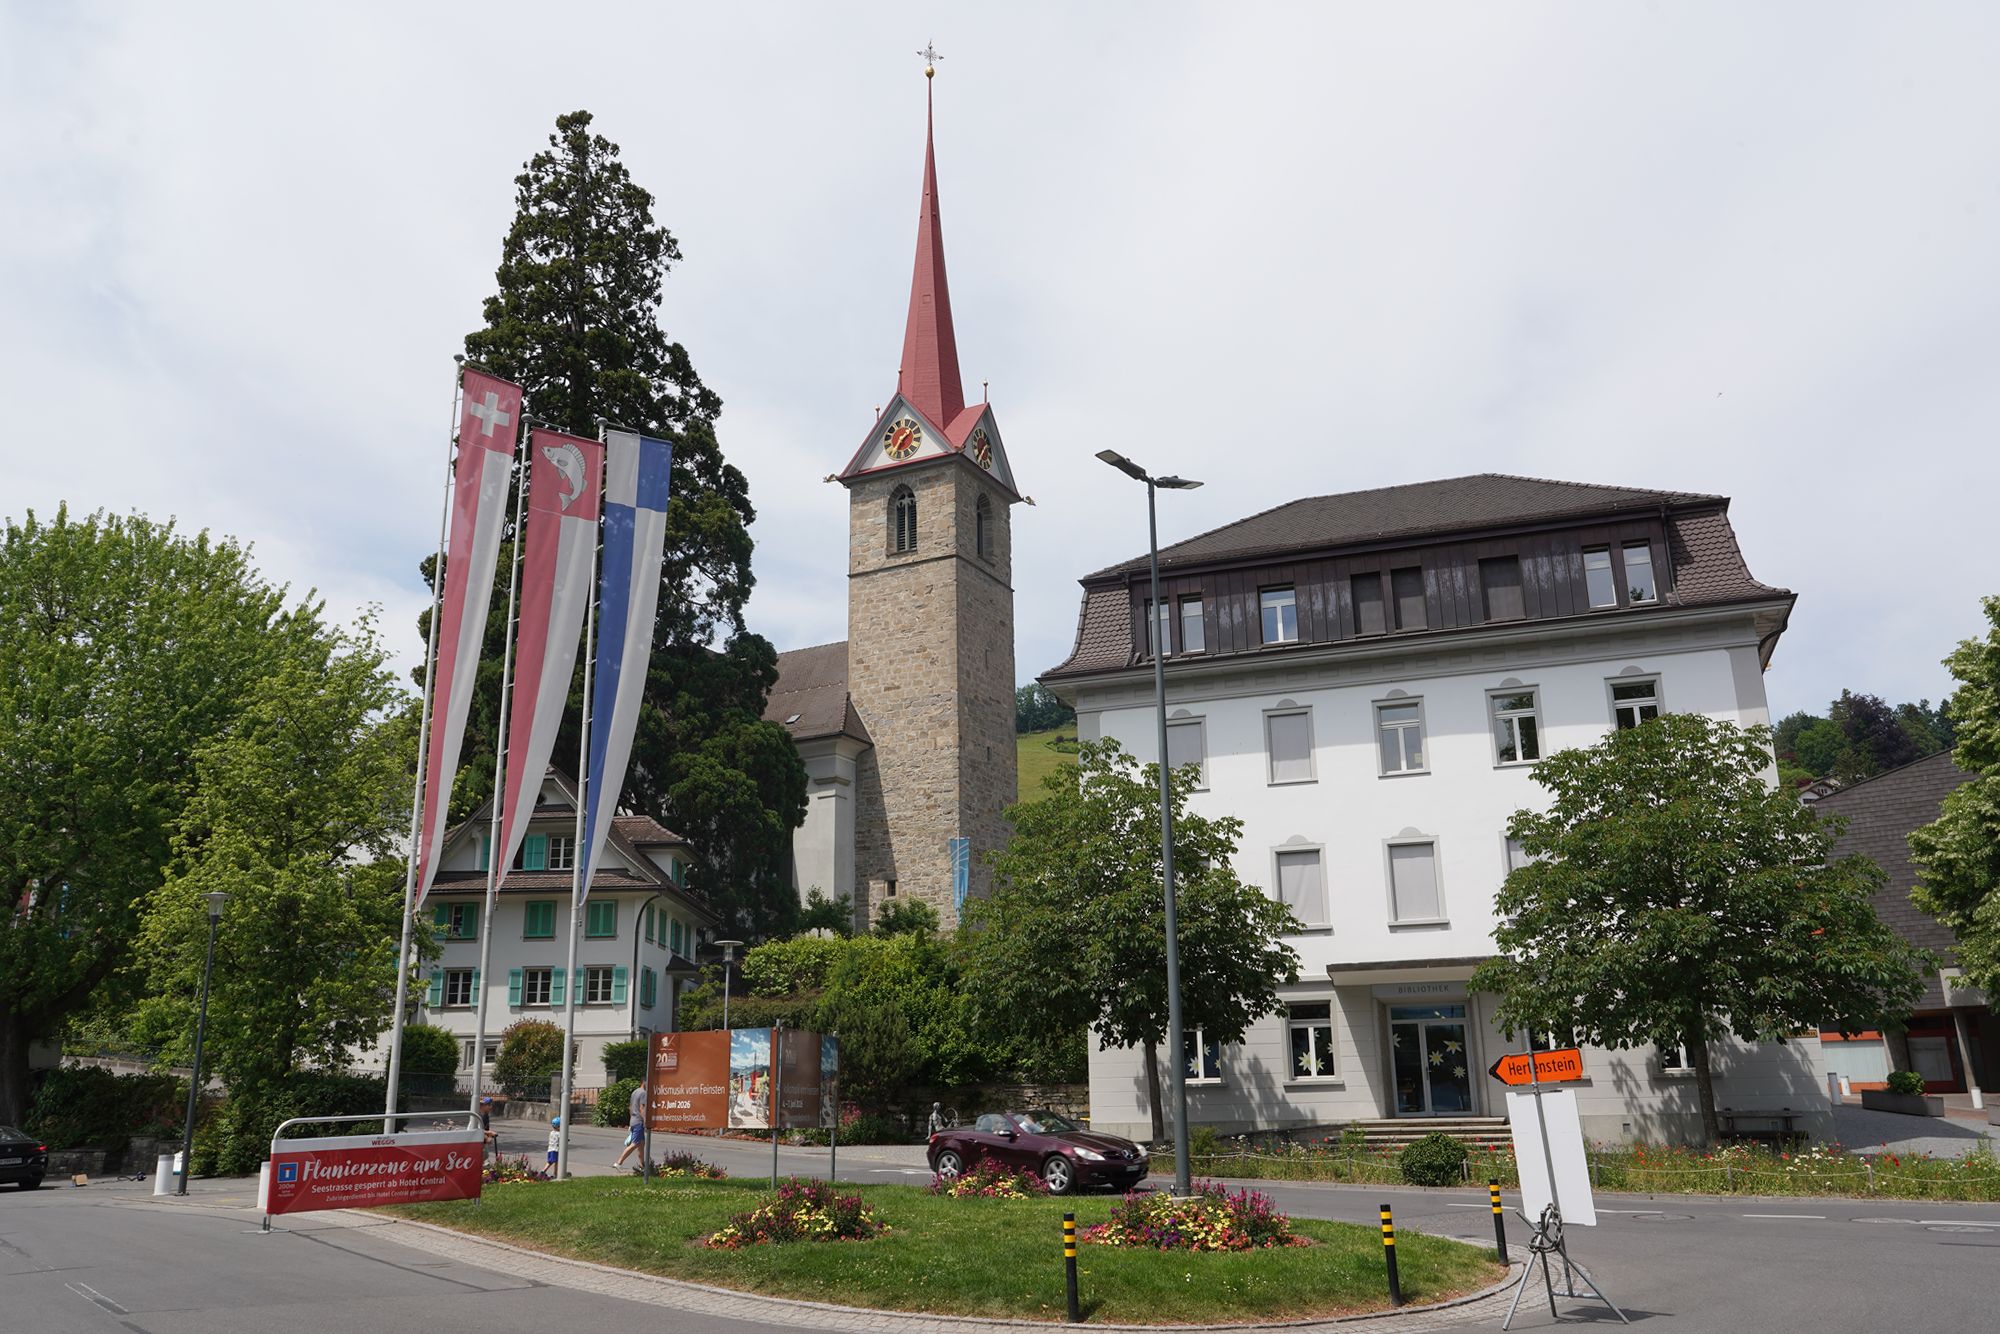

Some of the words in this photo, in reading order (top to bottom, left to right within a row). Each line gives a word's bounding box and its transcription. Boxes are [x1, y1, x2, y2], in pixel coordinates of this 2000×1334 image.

[1398, 984, 1449, 994] BIBLIOTHEK
[653, 1084, 685, 1096] Volksmusik
[685, 1086, 699, 1095] vom
[700, 1083, 726, 1095] Feinsten
[667, 1100, 677, 1110] Juni
[677, 1100, 691, 1109] 2026
[372, 1138, 396, 1146] WEGGIS
[302, 1158, 412, 1181] Flanierzone
[413, 1158, 444, 1173] am
[445, 1151, 475, 1171] See
[311, 1183, 353, 1194] Seestrasse
[353, 1180, 386, 1192] gesperrt
[387, 1178, 398, 1188] ab
[399, 1177, 419, 1187] Hotel
[419, 1175, 446, 1186] Central
